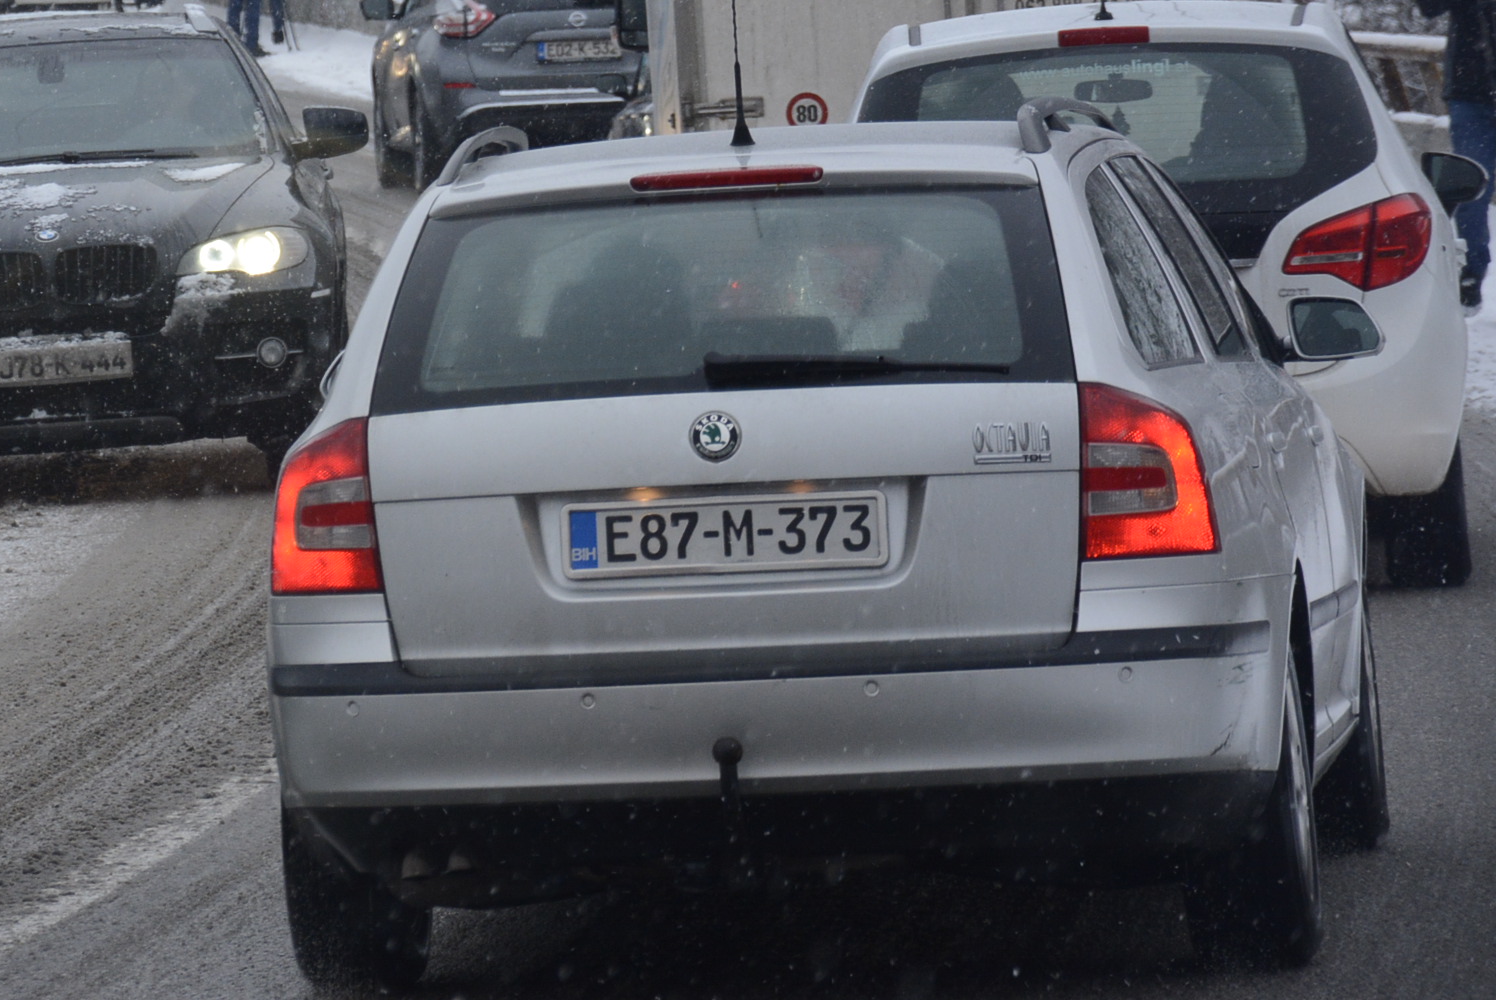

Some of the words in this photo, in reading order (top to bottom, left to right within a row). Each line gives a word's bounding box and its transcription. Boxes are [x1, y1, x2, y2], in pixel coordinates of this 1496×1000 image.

[796, 104, 818, 123] 80
[972, 422, 1051, 454] OCTAVIA
[1023, 454, 1042, 463] TDI
[571, 546, 596, 562] BIH
[606, 504, 871, 563] E87-M-373
